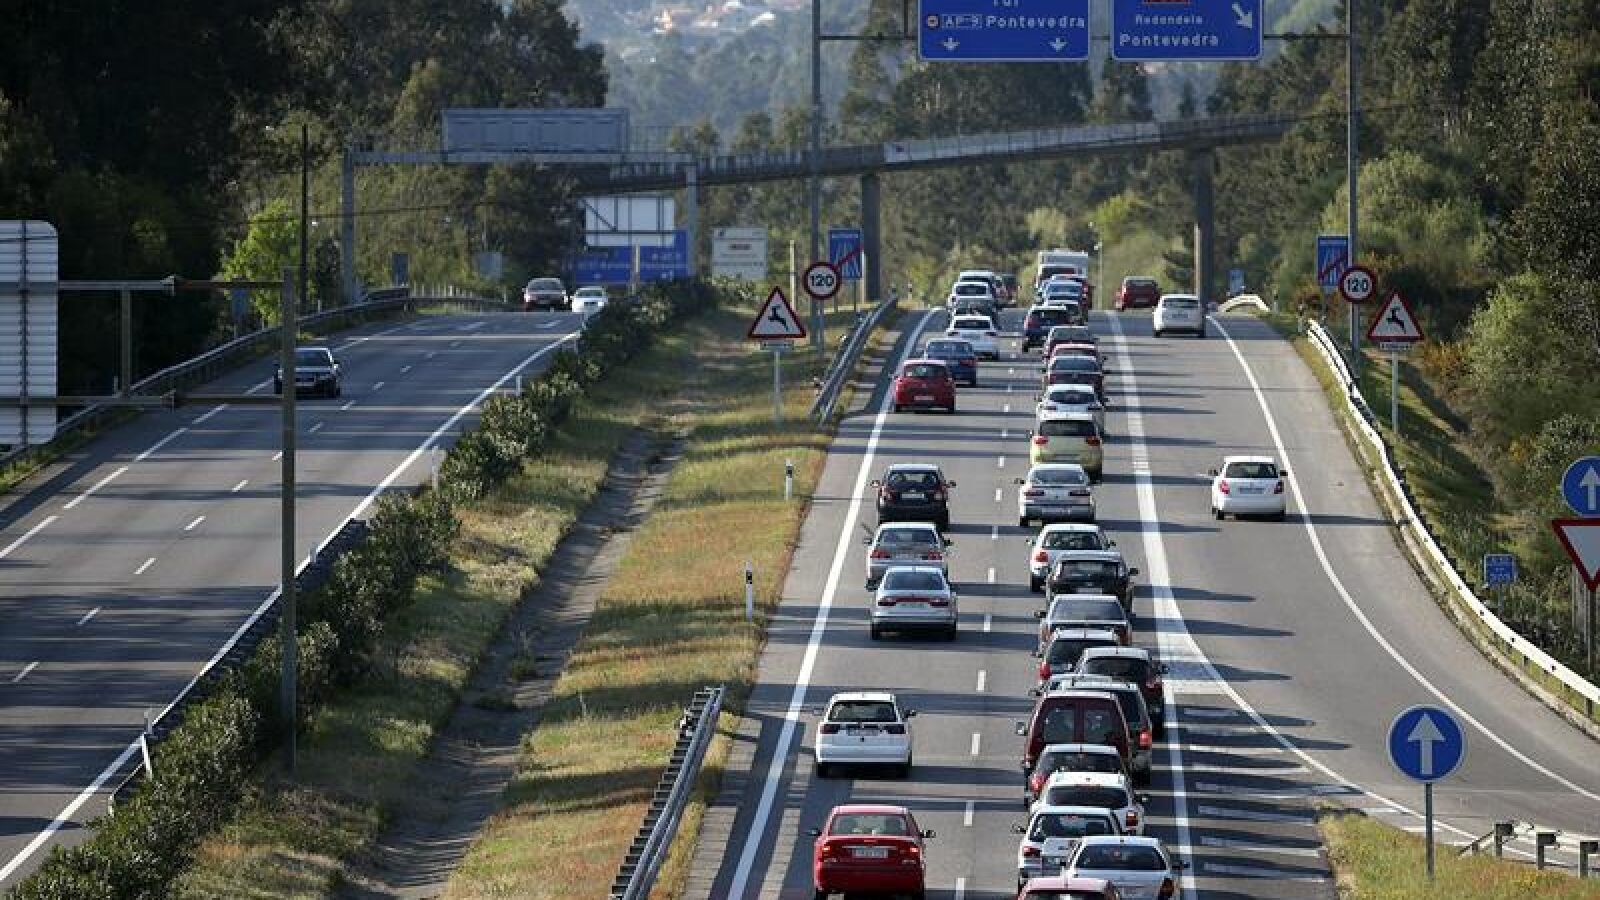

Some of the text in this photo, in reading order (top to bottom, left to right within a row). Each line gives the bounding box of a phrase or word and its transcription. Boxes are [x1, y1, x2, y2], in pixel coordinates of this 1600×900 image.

[985, 15, 1085, 29] Pontevedra
[1135, 15, 1203, 25] Redondela
[1119, 33, 1219, 47] Pontevedra
[810, 274, 835, 288] 120
[1347, 278, 1369, 293] 120
